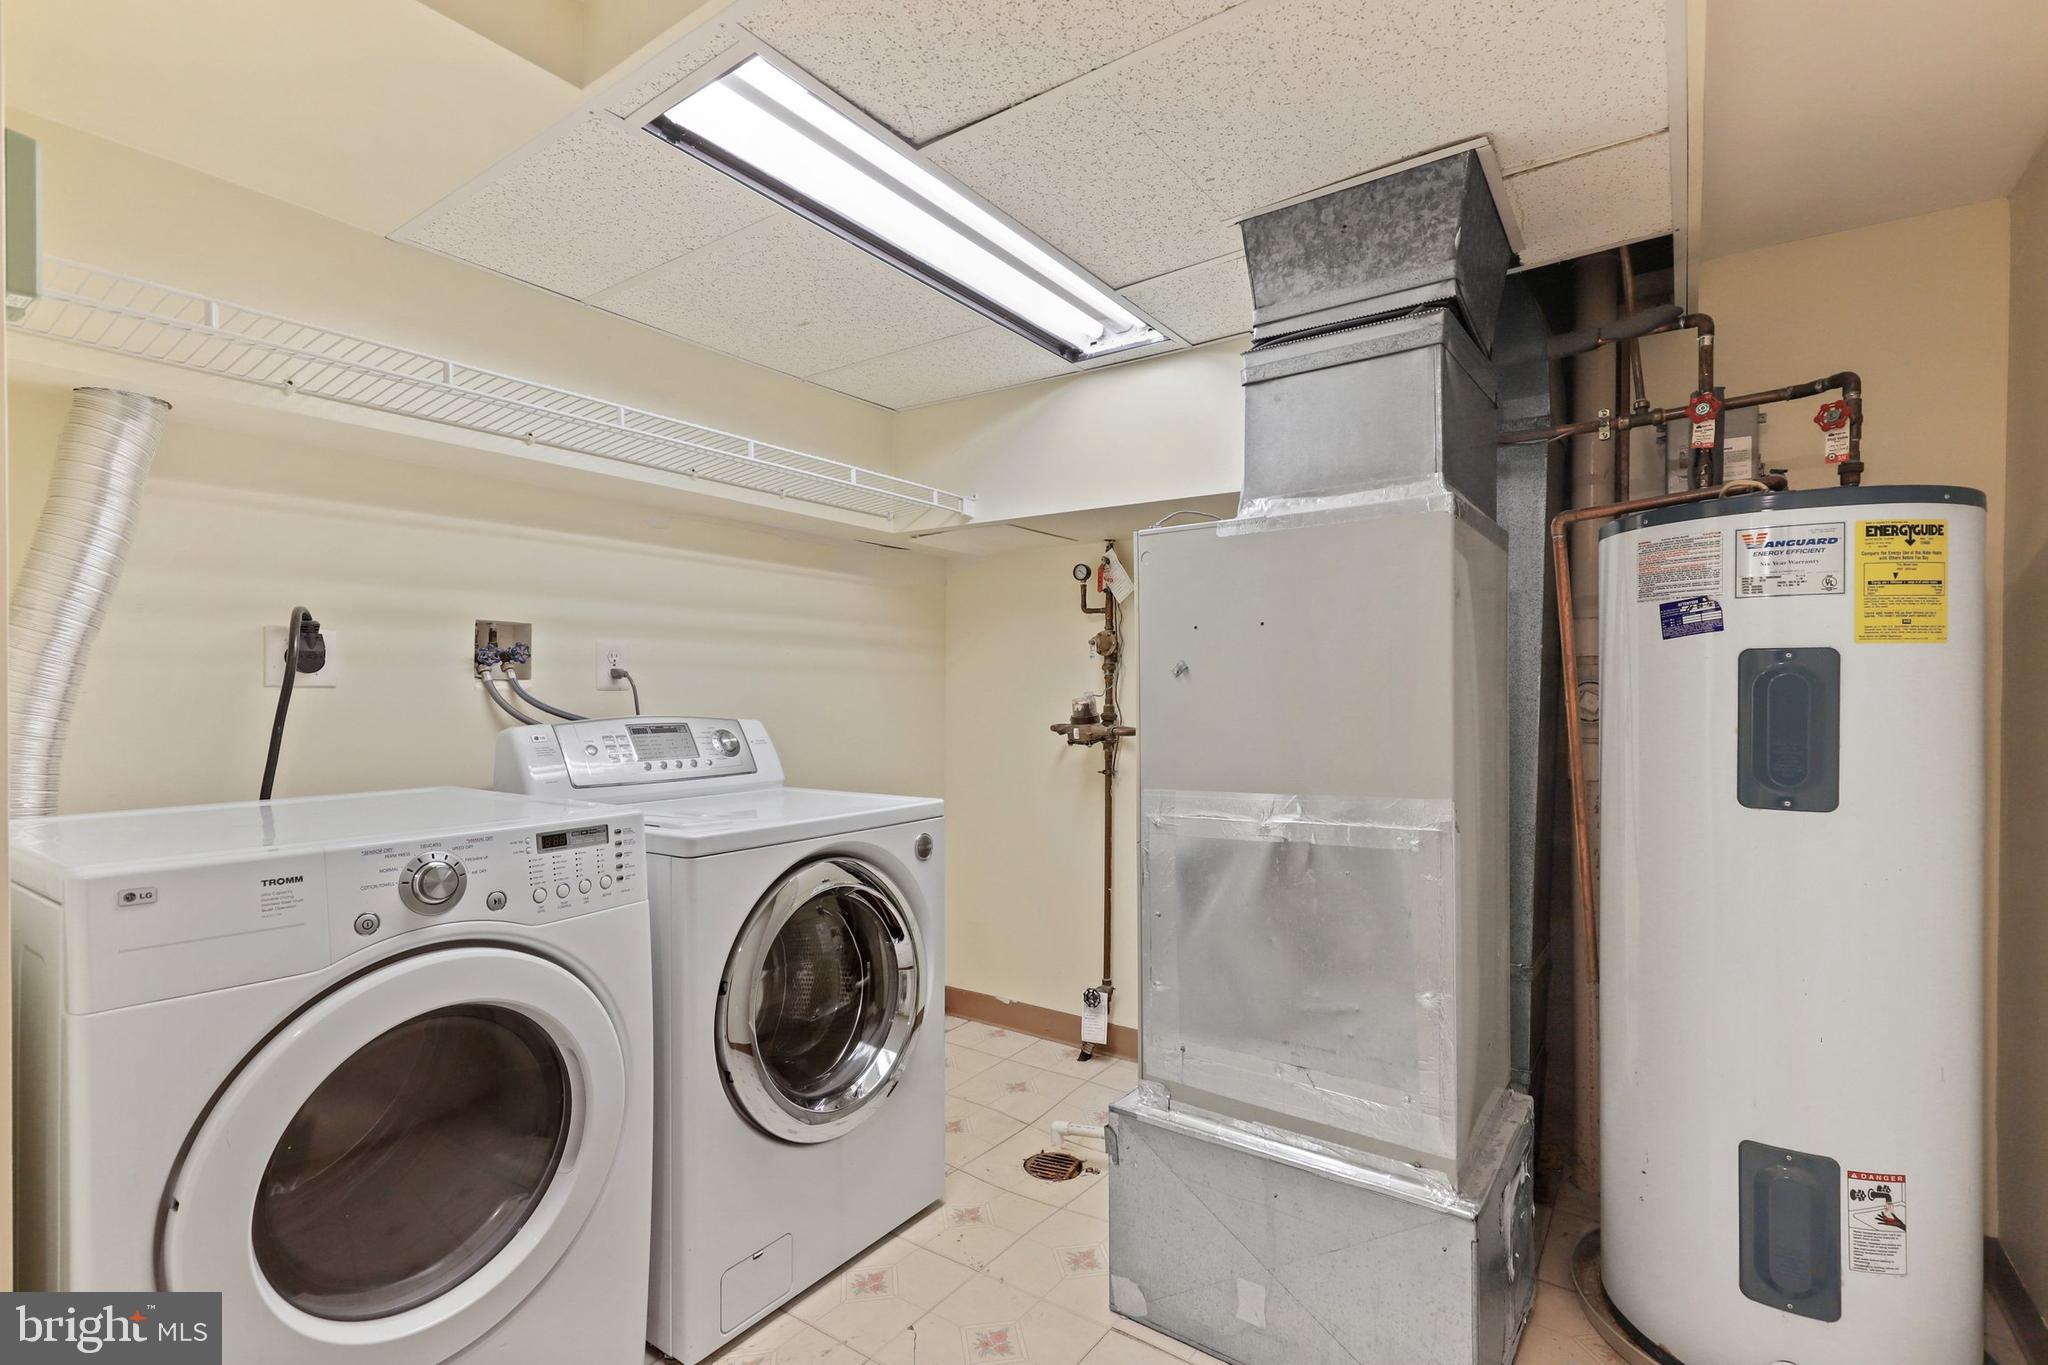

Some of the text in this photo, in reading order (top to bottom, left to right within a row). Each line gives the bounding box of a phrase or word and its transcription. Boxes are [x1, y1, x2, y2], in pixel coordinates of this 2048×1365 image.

[1786, 547, 1826, 555] EFFICIENT
[260, 875, 304, 887] TROMM
[139, 892, 153, 900] LG
[1861, 1174, 1903, 1182] DANGER
